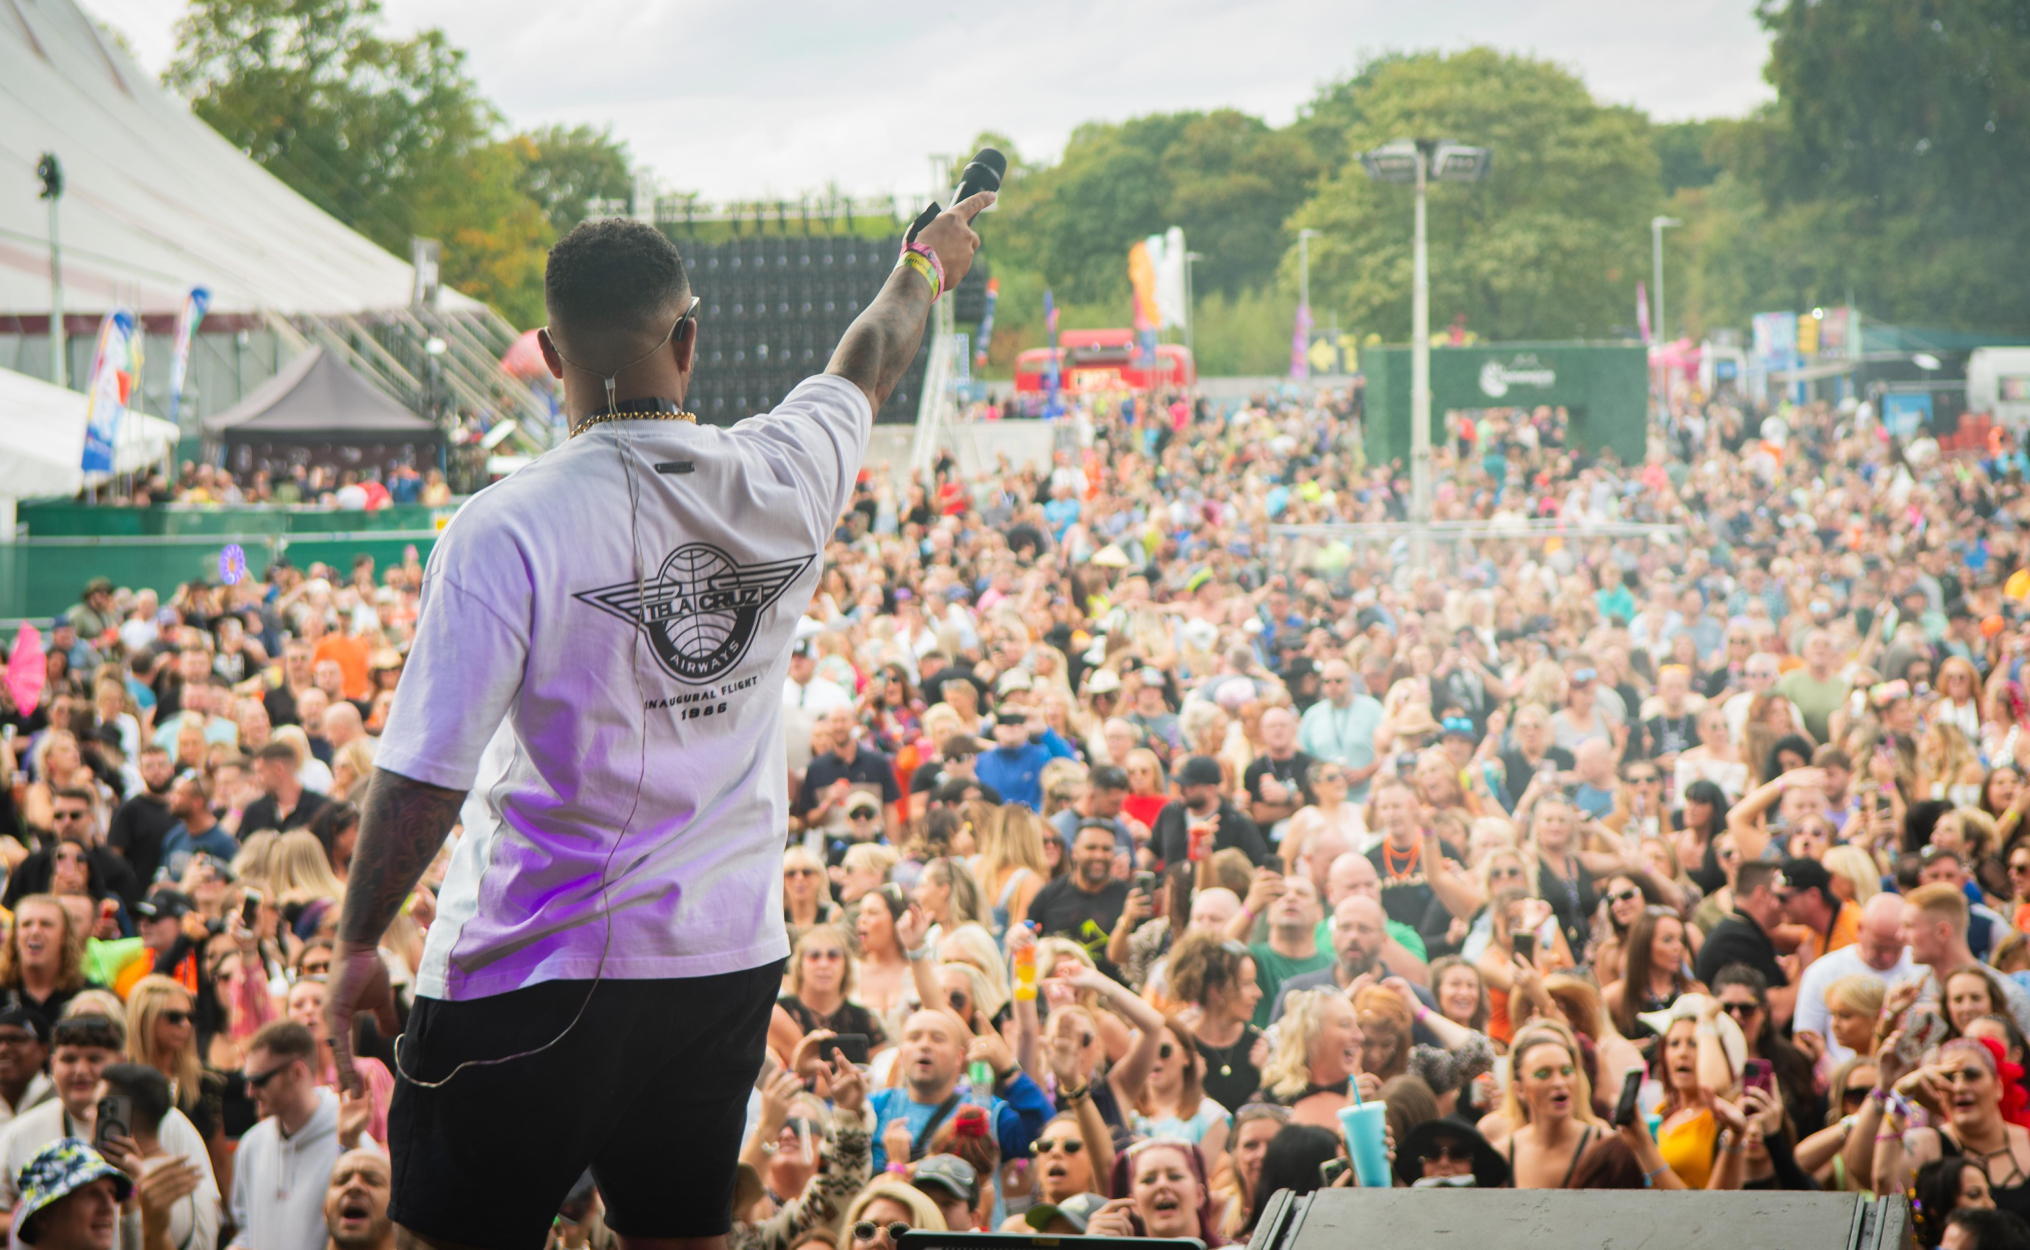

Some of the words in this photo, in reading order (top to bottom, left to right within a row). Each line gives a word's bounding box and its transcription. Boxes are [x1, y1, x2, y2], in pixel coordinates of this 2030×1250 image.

[699, 588, 761, 610] CRUZ
[670, 640, 739, 673] AIRWAYS
[645, 690, 716, 709] INAUGURAL
[721, 676, 757, 695] FLIGHT
